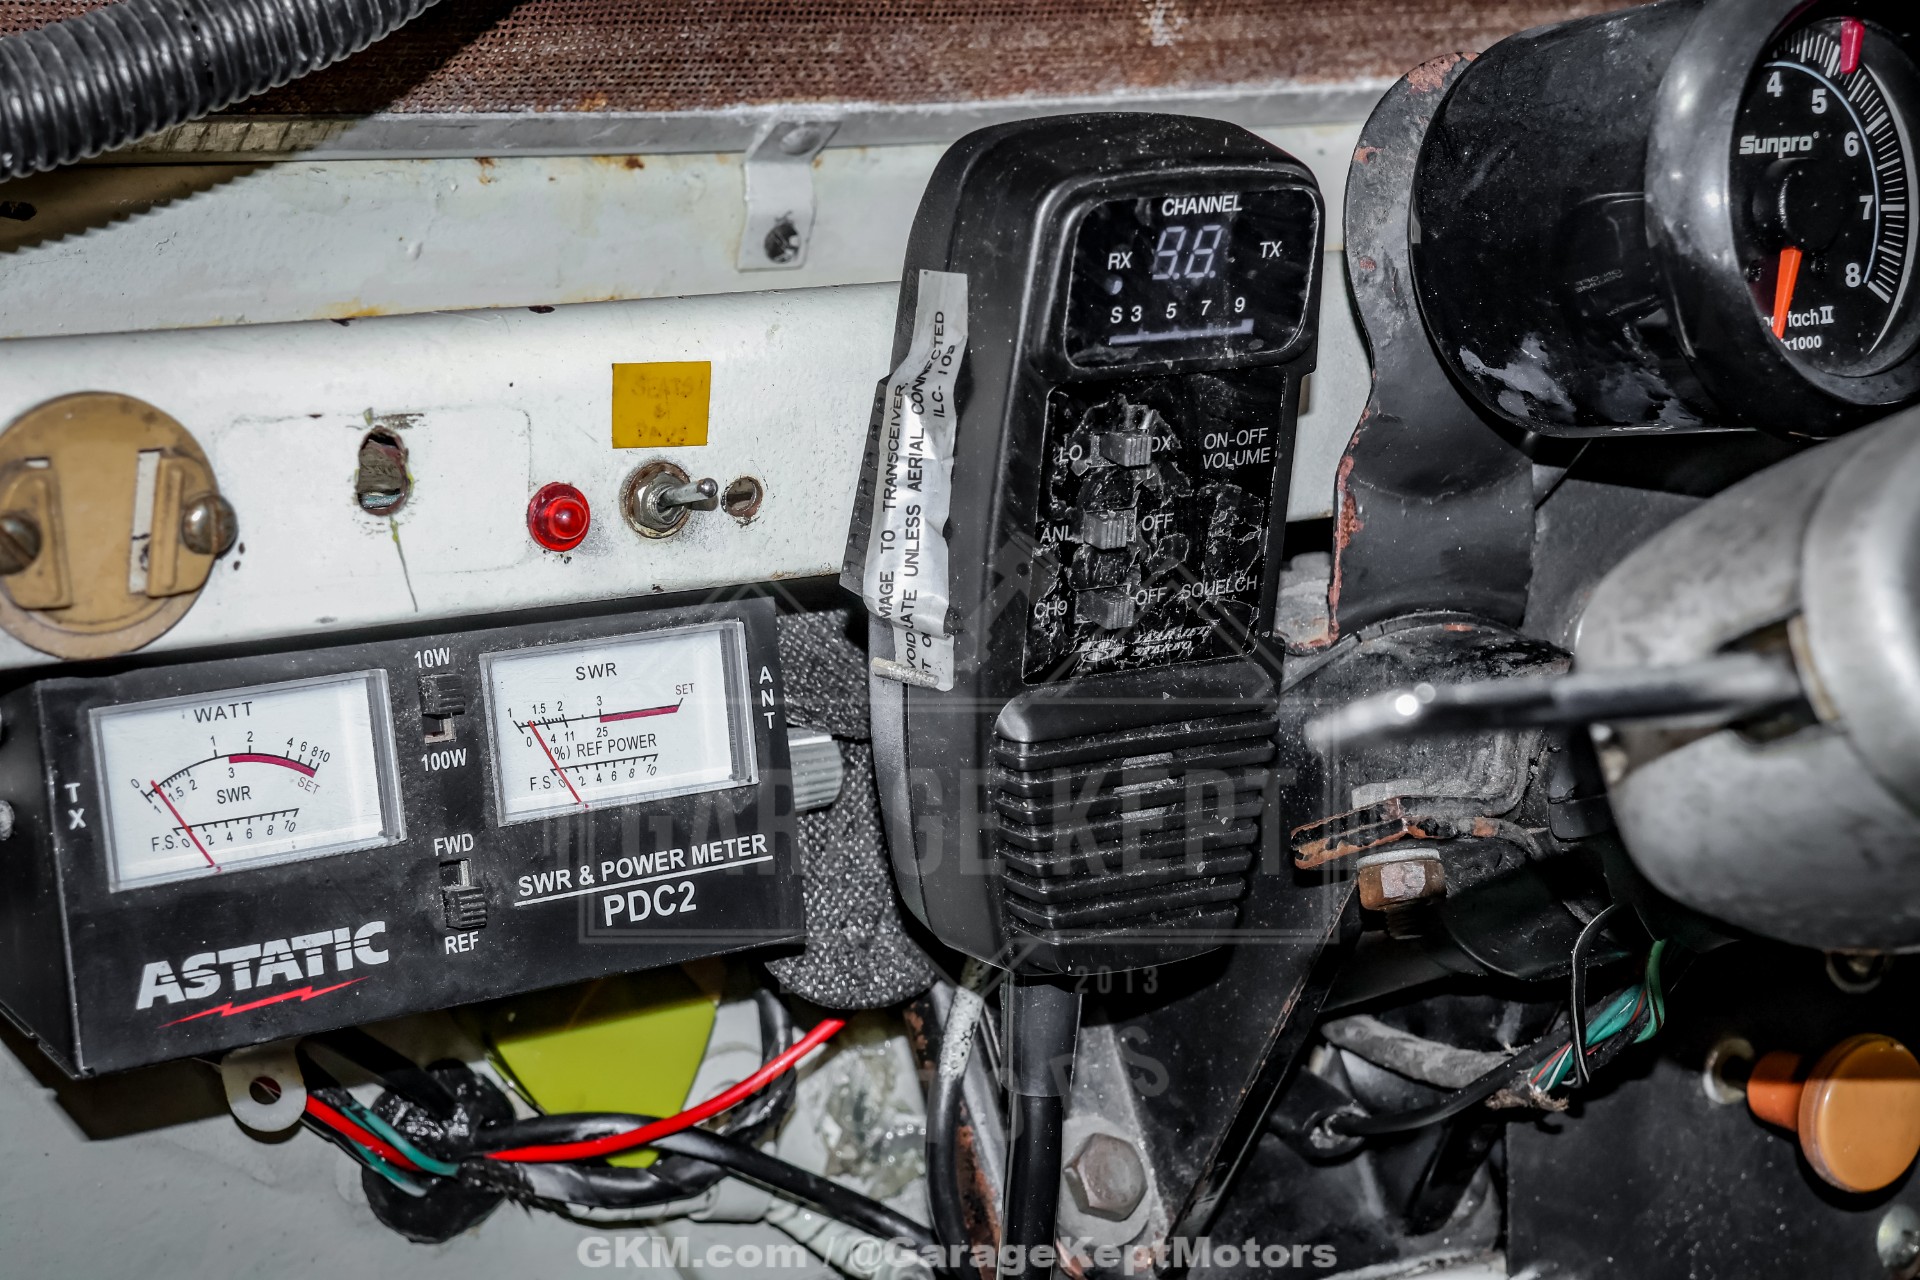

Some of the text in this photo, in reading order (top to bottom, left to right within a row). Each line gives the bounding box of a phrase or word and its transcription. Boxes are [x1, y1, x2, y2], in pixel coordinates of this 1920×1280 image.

[1766, 71, 1783, 97] 4
[1811, 88, 1827, 115] 5
[1843, 132, 1860, 157] 6
[1162, 195, 1242, 216] CHANNEL
[1859, 195, 1874, 221] 7
[1107, 252, 1133, 270] RX
[1259, 241, 1282, 258] TX
[1845, 262, 1861, 288] 8
[1110, 297, 1246, 324] S 3 5 7 9
[1204, 428, 1269, 449] ON-OFF
[907, 428, 925, 492] AERIAL
[1202, 448, 1271, 470] VOLUME
[904, 504, 921, 577] UNLESS
[1040, 513, 1174, 543] ANL OFF
[880, 529, 896, 554] TO
[878, 570, 895, 619] MAGE
[1182, 576, 1258, 600] SQUELCH
[1033, 587, 1168, 618] CH9 OFF
[414, 647, 451, 669] 10W
[906, 632, 917, 669] VOID
[575, 662, 617, 681] SWR
[194, 701, 253, 723] WATT
[508, 683, 695, 718] 1 1.5 2 3 SET
[525, 727, 608, 747] 0 4 11 25
[577, 741, 602, 757] REF
[608, 733, 657, 753] POWER
[130, 731, 331, 789] 0 1 2 4 6 8 10
[421, 748, 467, 772] 100W
[579, 776, 586, 786] 2
[596, 773, 602, 783] 4
[611, 771, 617, 781] 6
[629, 768, 635, 778] 8
[647, 764, 657, 776] 10
[153, 768, 320, 814] 1 1.5 2 3 SET
[217, 786, 252, 804] SWR
[151, 820, 296, 851] F.S. 0 2 4 6 8 10
[434, 834, 474, 856] FWD
[518, 833, 767, 897] SWR & POWER METER
[603, 881, 697, 927] PDC2
[444, 931, 480, 955] REF
[136, 920, 390, 1010] ASTATIC
